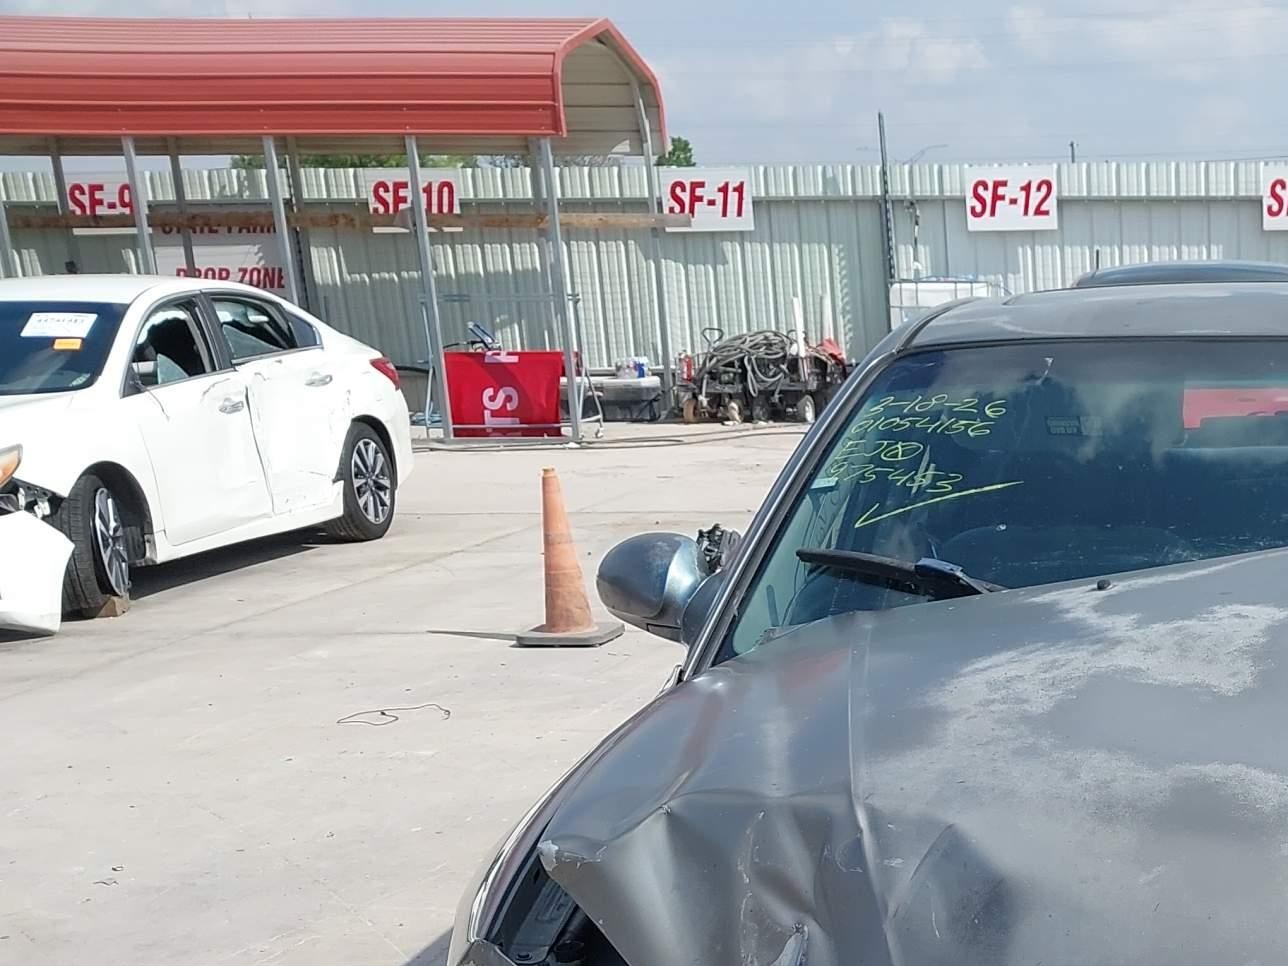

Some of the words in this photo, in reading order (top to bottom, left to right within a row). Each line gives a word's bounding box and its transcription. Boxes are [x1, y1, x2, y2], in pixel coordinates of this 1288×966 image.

[69, 183, 133, 216] SF-9
[372, 180, 455, 214] SF10
[668, 180, 745, 218] SF-11
[970, 179, 1053, 218] SF-12
